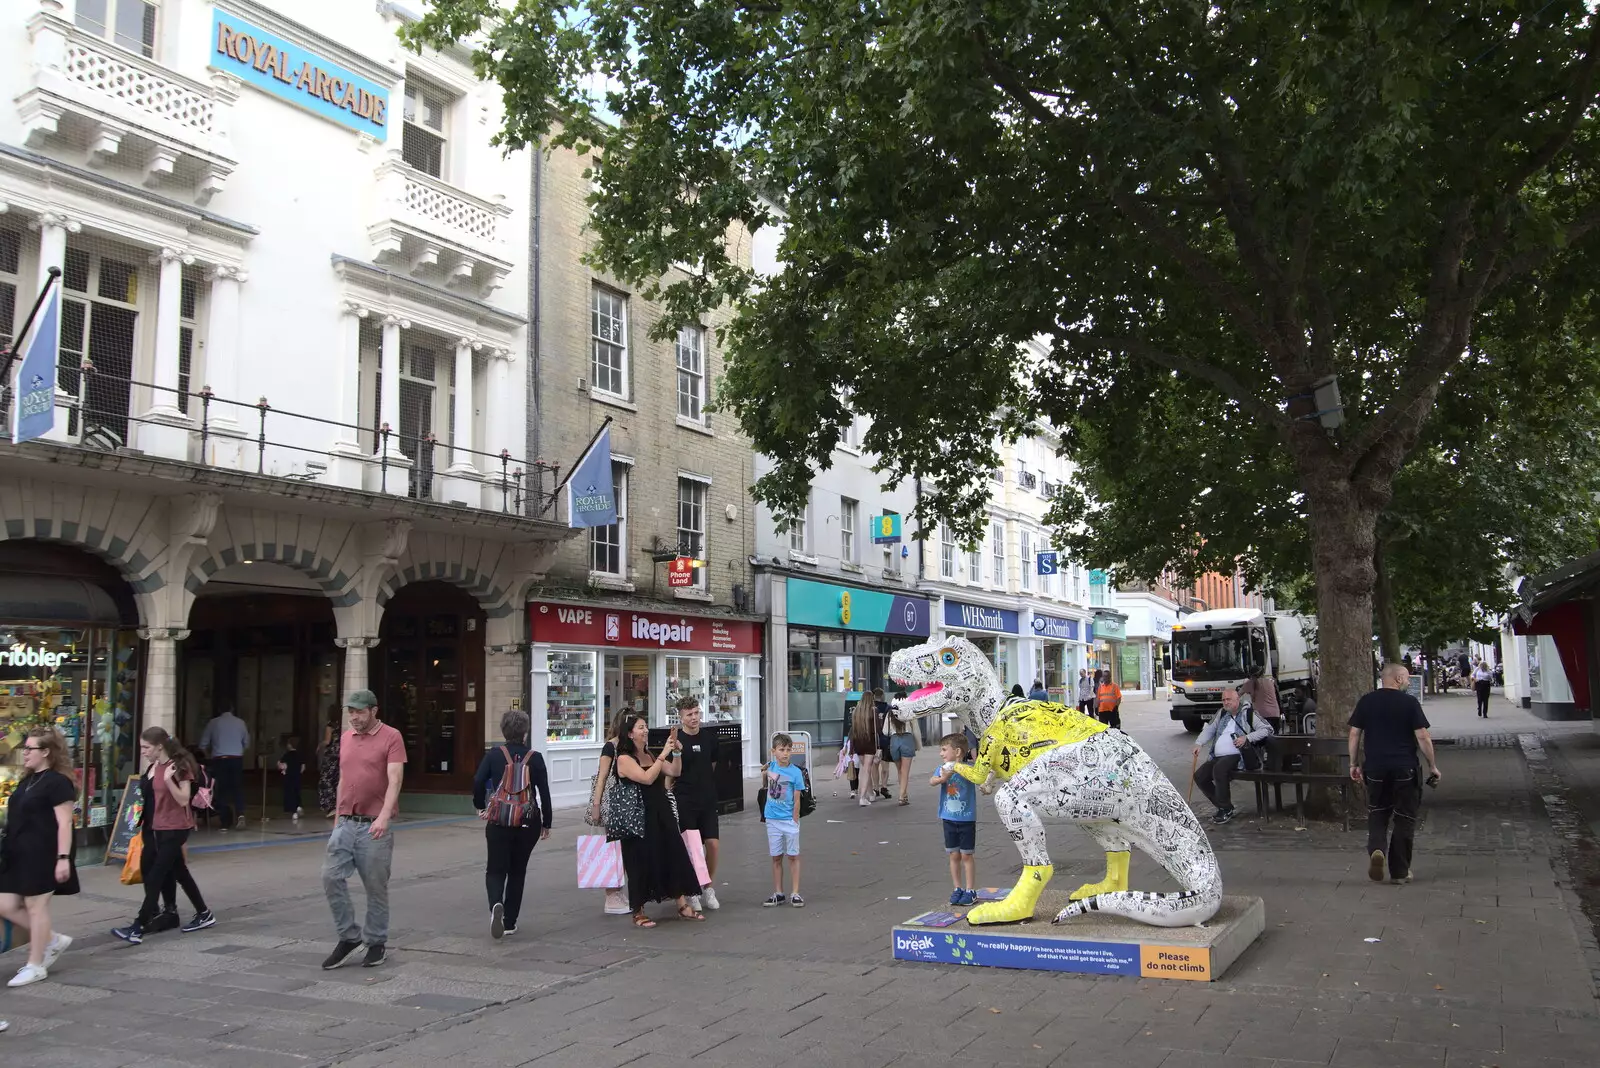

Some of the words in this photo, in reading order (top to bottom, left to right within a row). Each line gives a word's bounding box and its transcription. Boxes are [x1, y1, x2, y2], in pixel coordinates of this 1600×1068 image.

[296, 61, 386, 126] ARCADE
[575, 495, 610, 506] ROYAL
[1042, 559, 1052, 574] S
[906, 611, 914, 622] BT
[961, 604, 1004, 630] WHSmith
[558, 608, 592, 625] VAPE
[632, 614, 694, 646] iRepair
[897, 936, 934, 950] break
[990, 942, 1008, 950] really
[1010, 944, 1032, 952] happy
[1158, 952, 1190, 961] Please
[1178, 964, 1205, 972] climb
